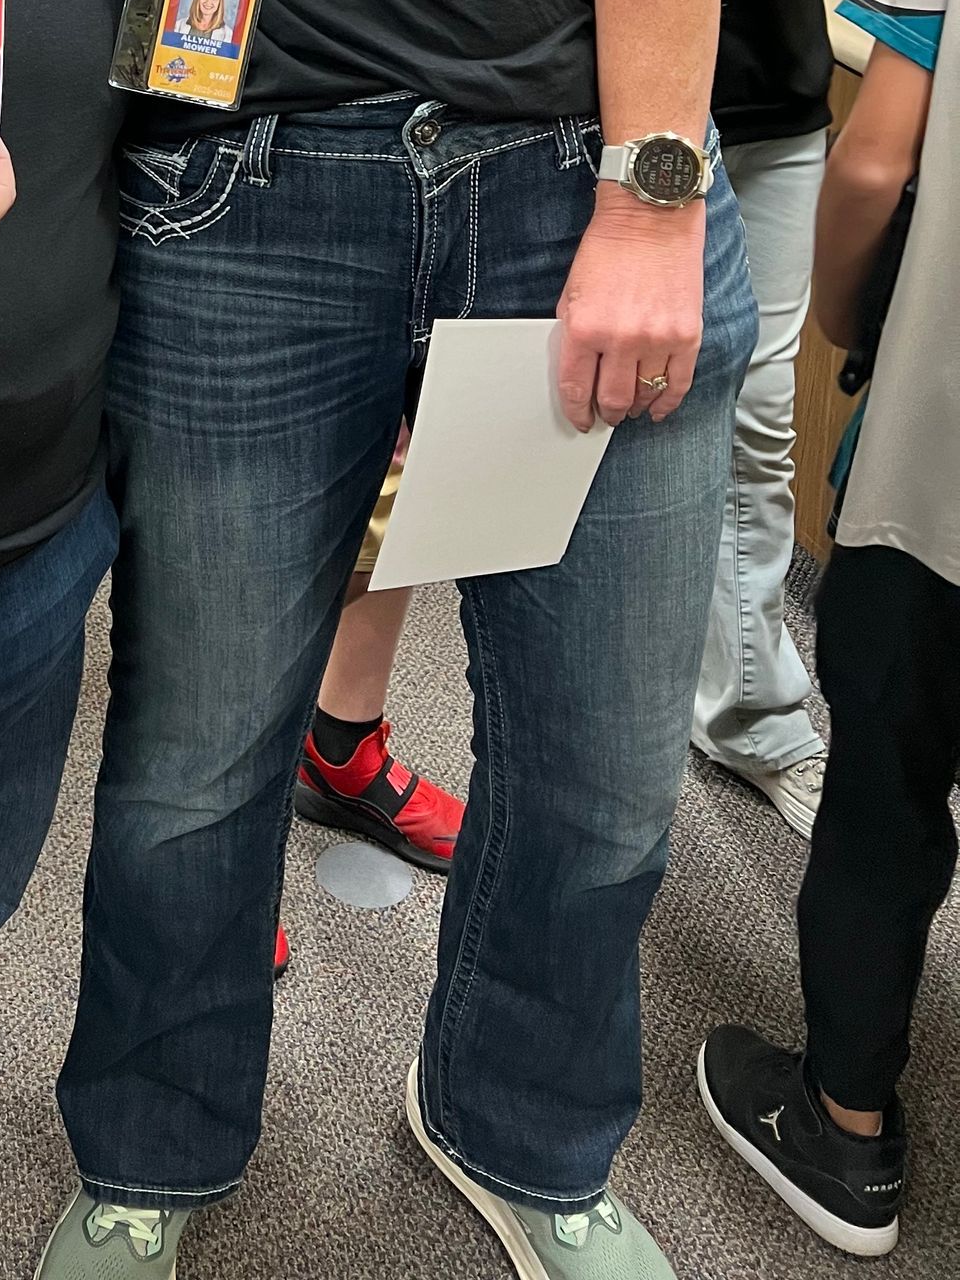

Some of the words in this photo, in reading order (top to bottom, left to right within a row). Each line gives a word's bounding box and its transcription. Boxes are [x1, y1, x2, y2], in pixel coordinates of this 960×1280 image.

[181, 34, 223, 48] ALLYNNE
[183, 42, 218, 55] MOWER
[209, 72, 235, 82] STAFF
[863, 1180, 902, 1191] JORDA
